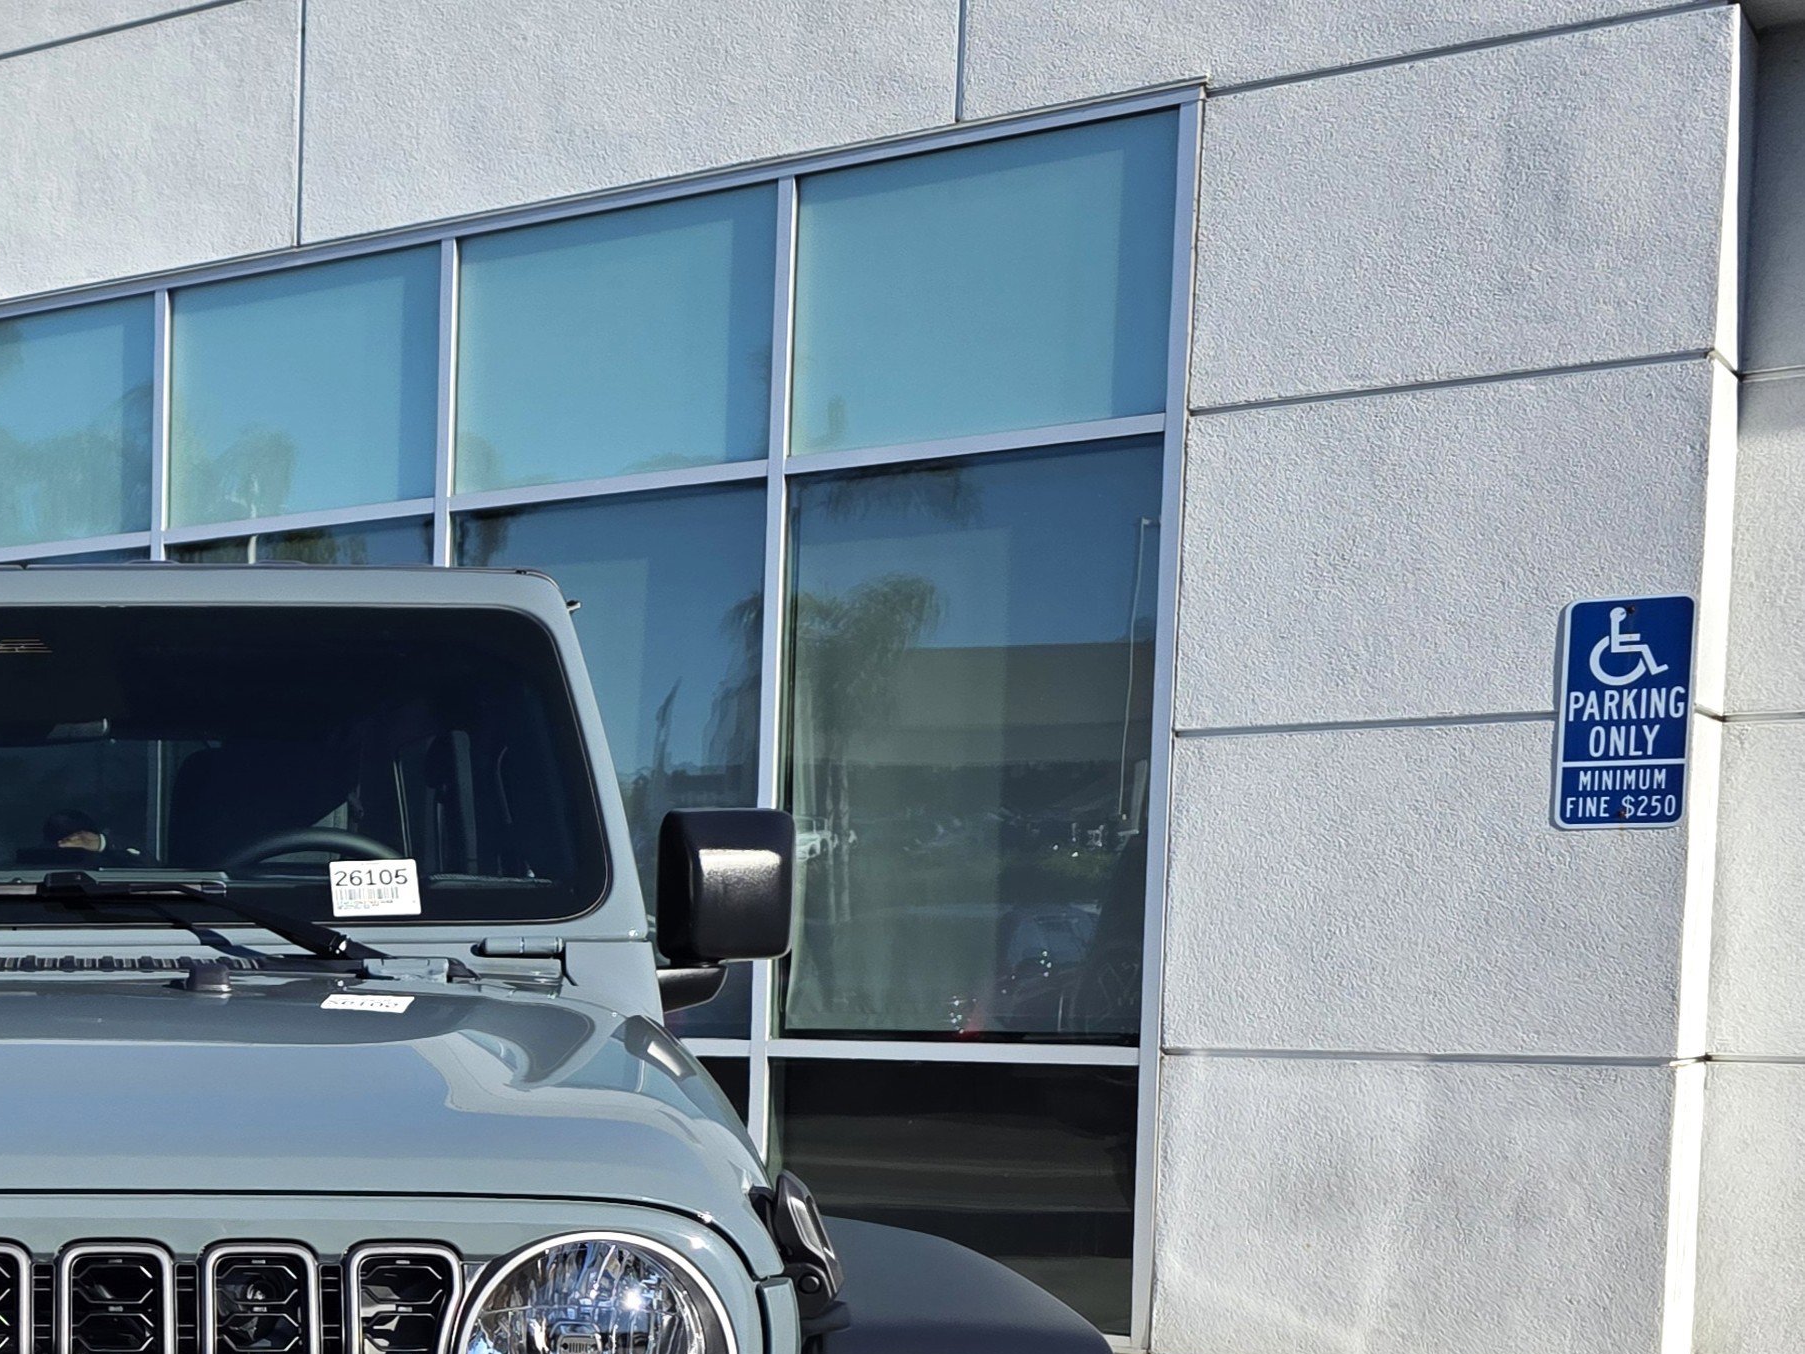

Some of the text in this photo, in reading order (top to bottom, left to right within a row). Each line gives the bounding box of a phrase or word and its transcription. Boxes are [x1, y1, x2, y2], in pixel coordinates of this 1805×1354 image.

[1568, 686, 1686, 722] PARKING
[1589, 724, 1661, 757] ONLY
[1578, 768, 1666, 791] MINIMUM
[1566, 794, 1676, 819] FINE $250
[334, 868, 408, 887] 26105
